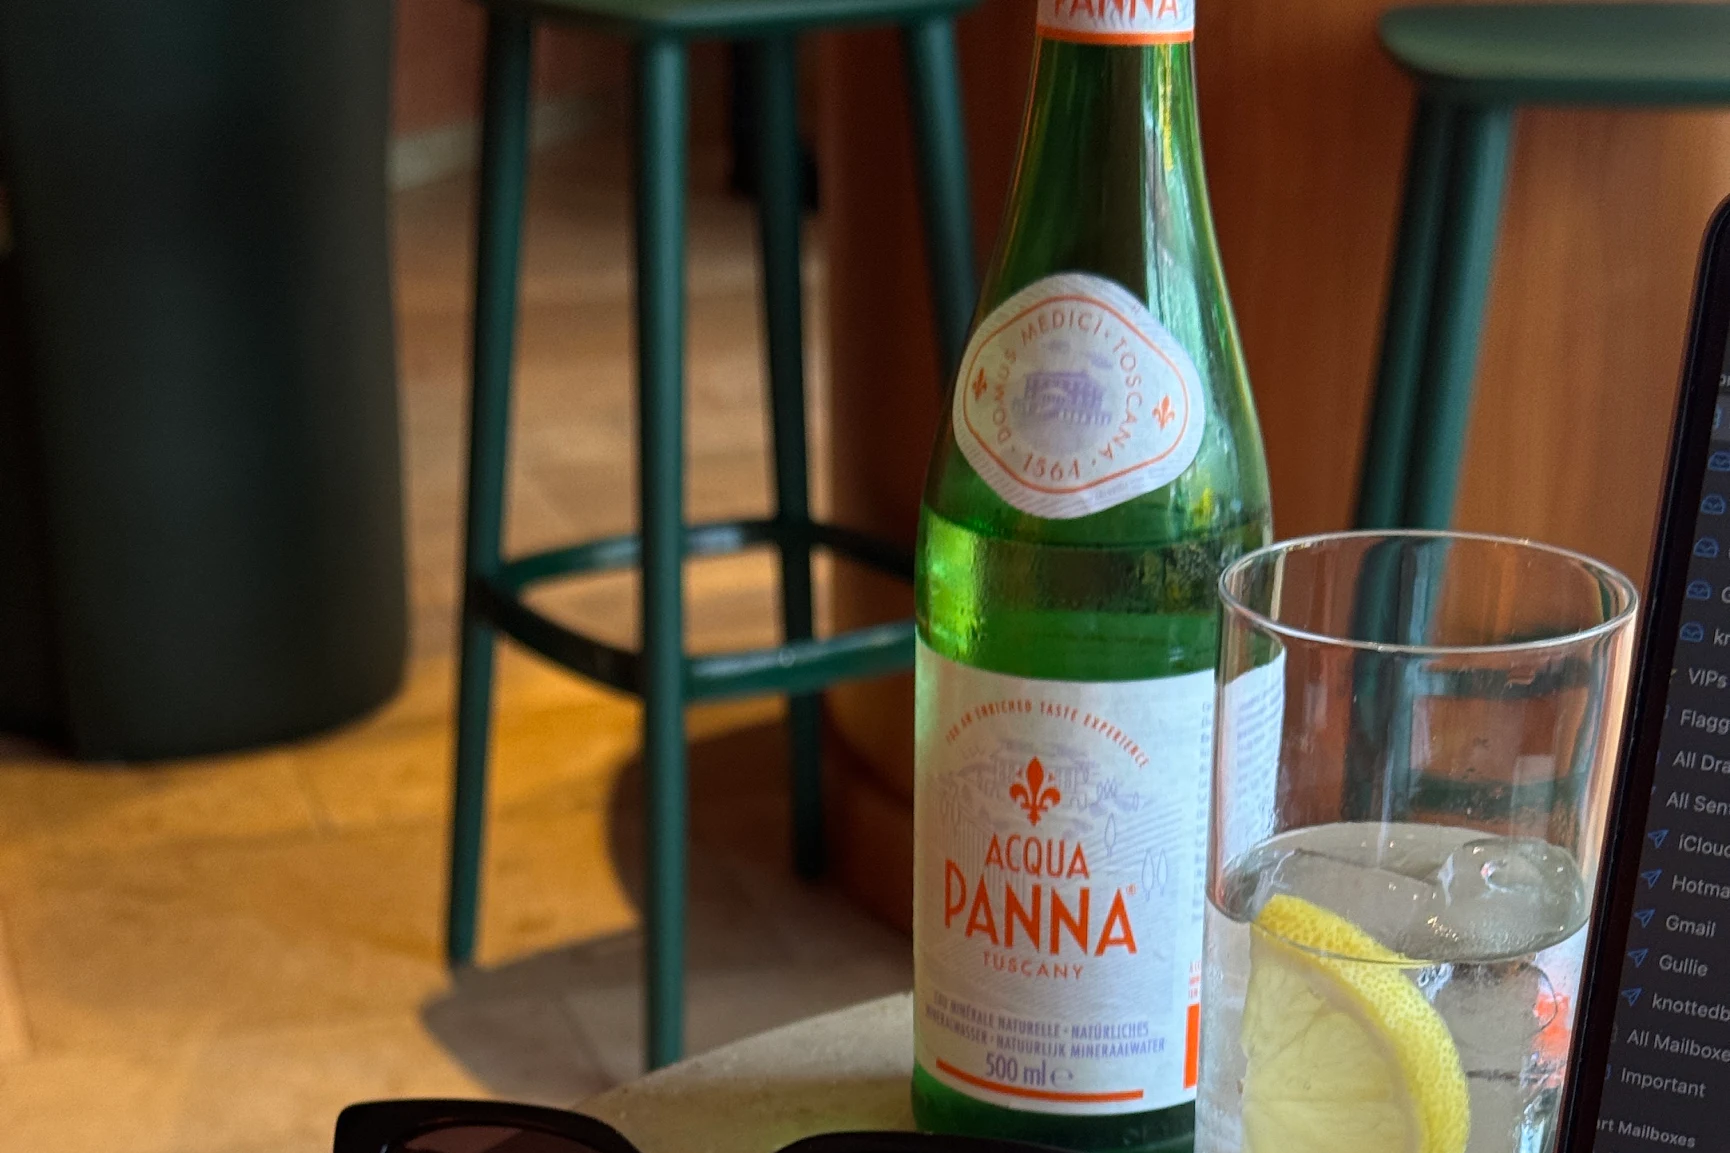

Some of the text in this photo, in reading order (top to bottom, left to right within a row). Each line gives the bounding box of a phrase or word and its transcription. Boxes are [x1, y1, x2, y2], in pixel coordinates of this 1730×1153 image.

[1020, 309, 1103, 346] MEDICI
[1099, 336, 1144, 460] TOSCANA
[1688, 667, 1728, 689] VIPs
[1039, 700, 1079, 723] TASTE
[1083, 712, 1150, 769] EXPERIENCE
[1672, 750, 1697, 769] All
[1665, 791, 1730, 816] All Sen
[985, 831, 1091, 879] ACQUA
[1671, 874, 1730, 899] Hotma
[943, 858, 1138, 957] PANNA
[1665, 914, 1717, 938] Gmail
[983, 950, 1084, 980] TUSCANY
[1658, 953, 1708, 977] Gullie
[1651, 992, 1730, 1021] knottedb
[998, 1015, 1060, 1038] NATURELLE
[1071, 1020, 1149, 1040] NATÜRLICHES
[1626, 1029, 1650, 1047] All
[996, 1033, 1066, 1058] NATUURLIJK
[1070, 1037, 1165, 1059] MINERAALWATER
[985, 1052, 1019, 1084] 500
[1023, 1058, 1047, 1087] ml
[1620, 1067, 1707, 1098] Important
[1617, 1120, 1696, 1149] Mailboxes
